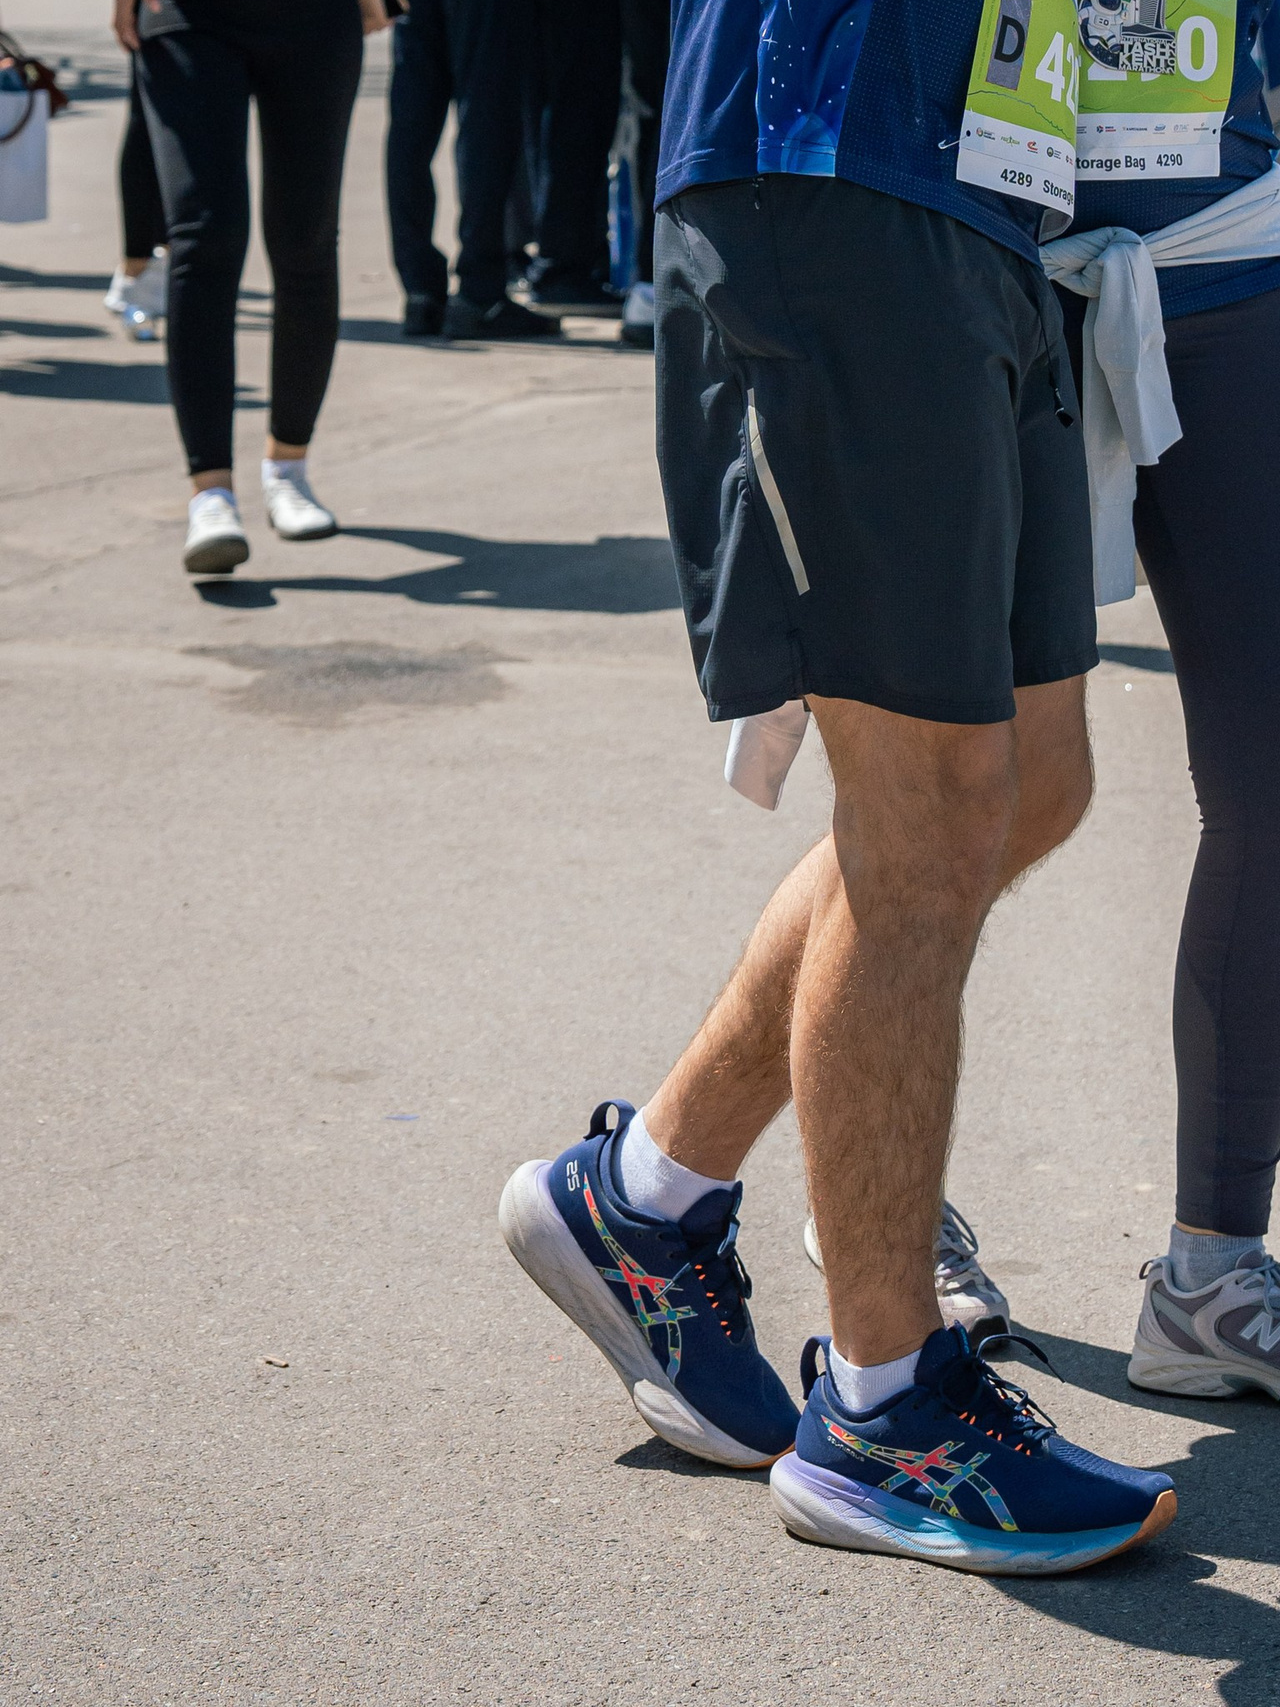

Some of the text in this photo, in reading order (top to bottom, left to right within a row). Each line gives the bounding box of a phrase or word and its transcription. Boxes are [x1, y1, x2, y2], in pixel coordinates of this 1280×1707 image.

[993, 14, 1026, 64] D
[1119, 41, 1169, 58] TASH
[1118, 51, 1169, 68] KENT
[1118, 64, 1169, 74] MARATHON
[1125, 155, 1146, 171] Bag
[1156, 153, 1183, 167] 4290
[1000, 168, 1033, 188] 4289
[566, 1159, 580, 1192] 25
